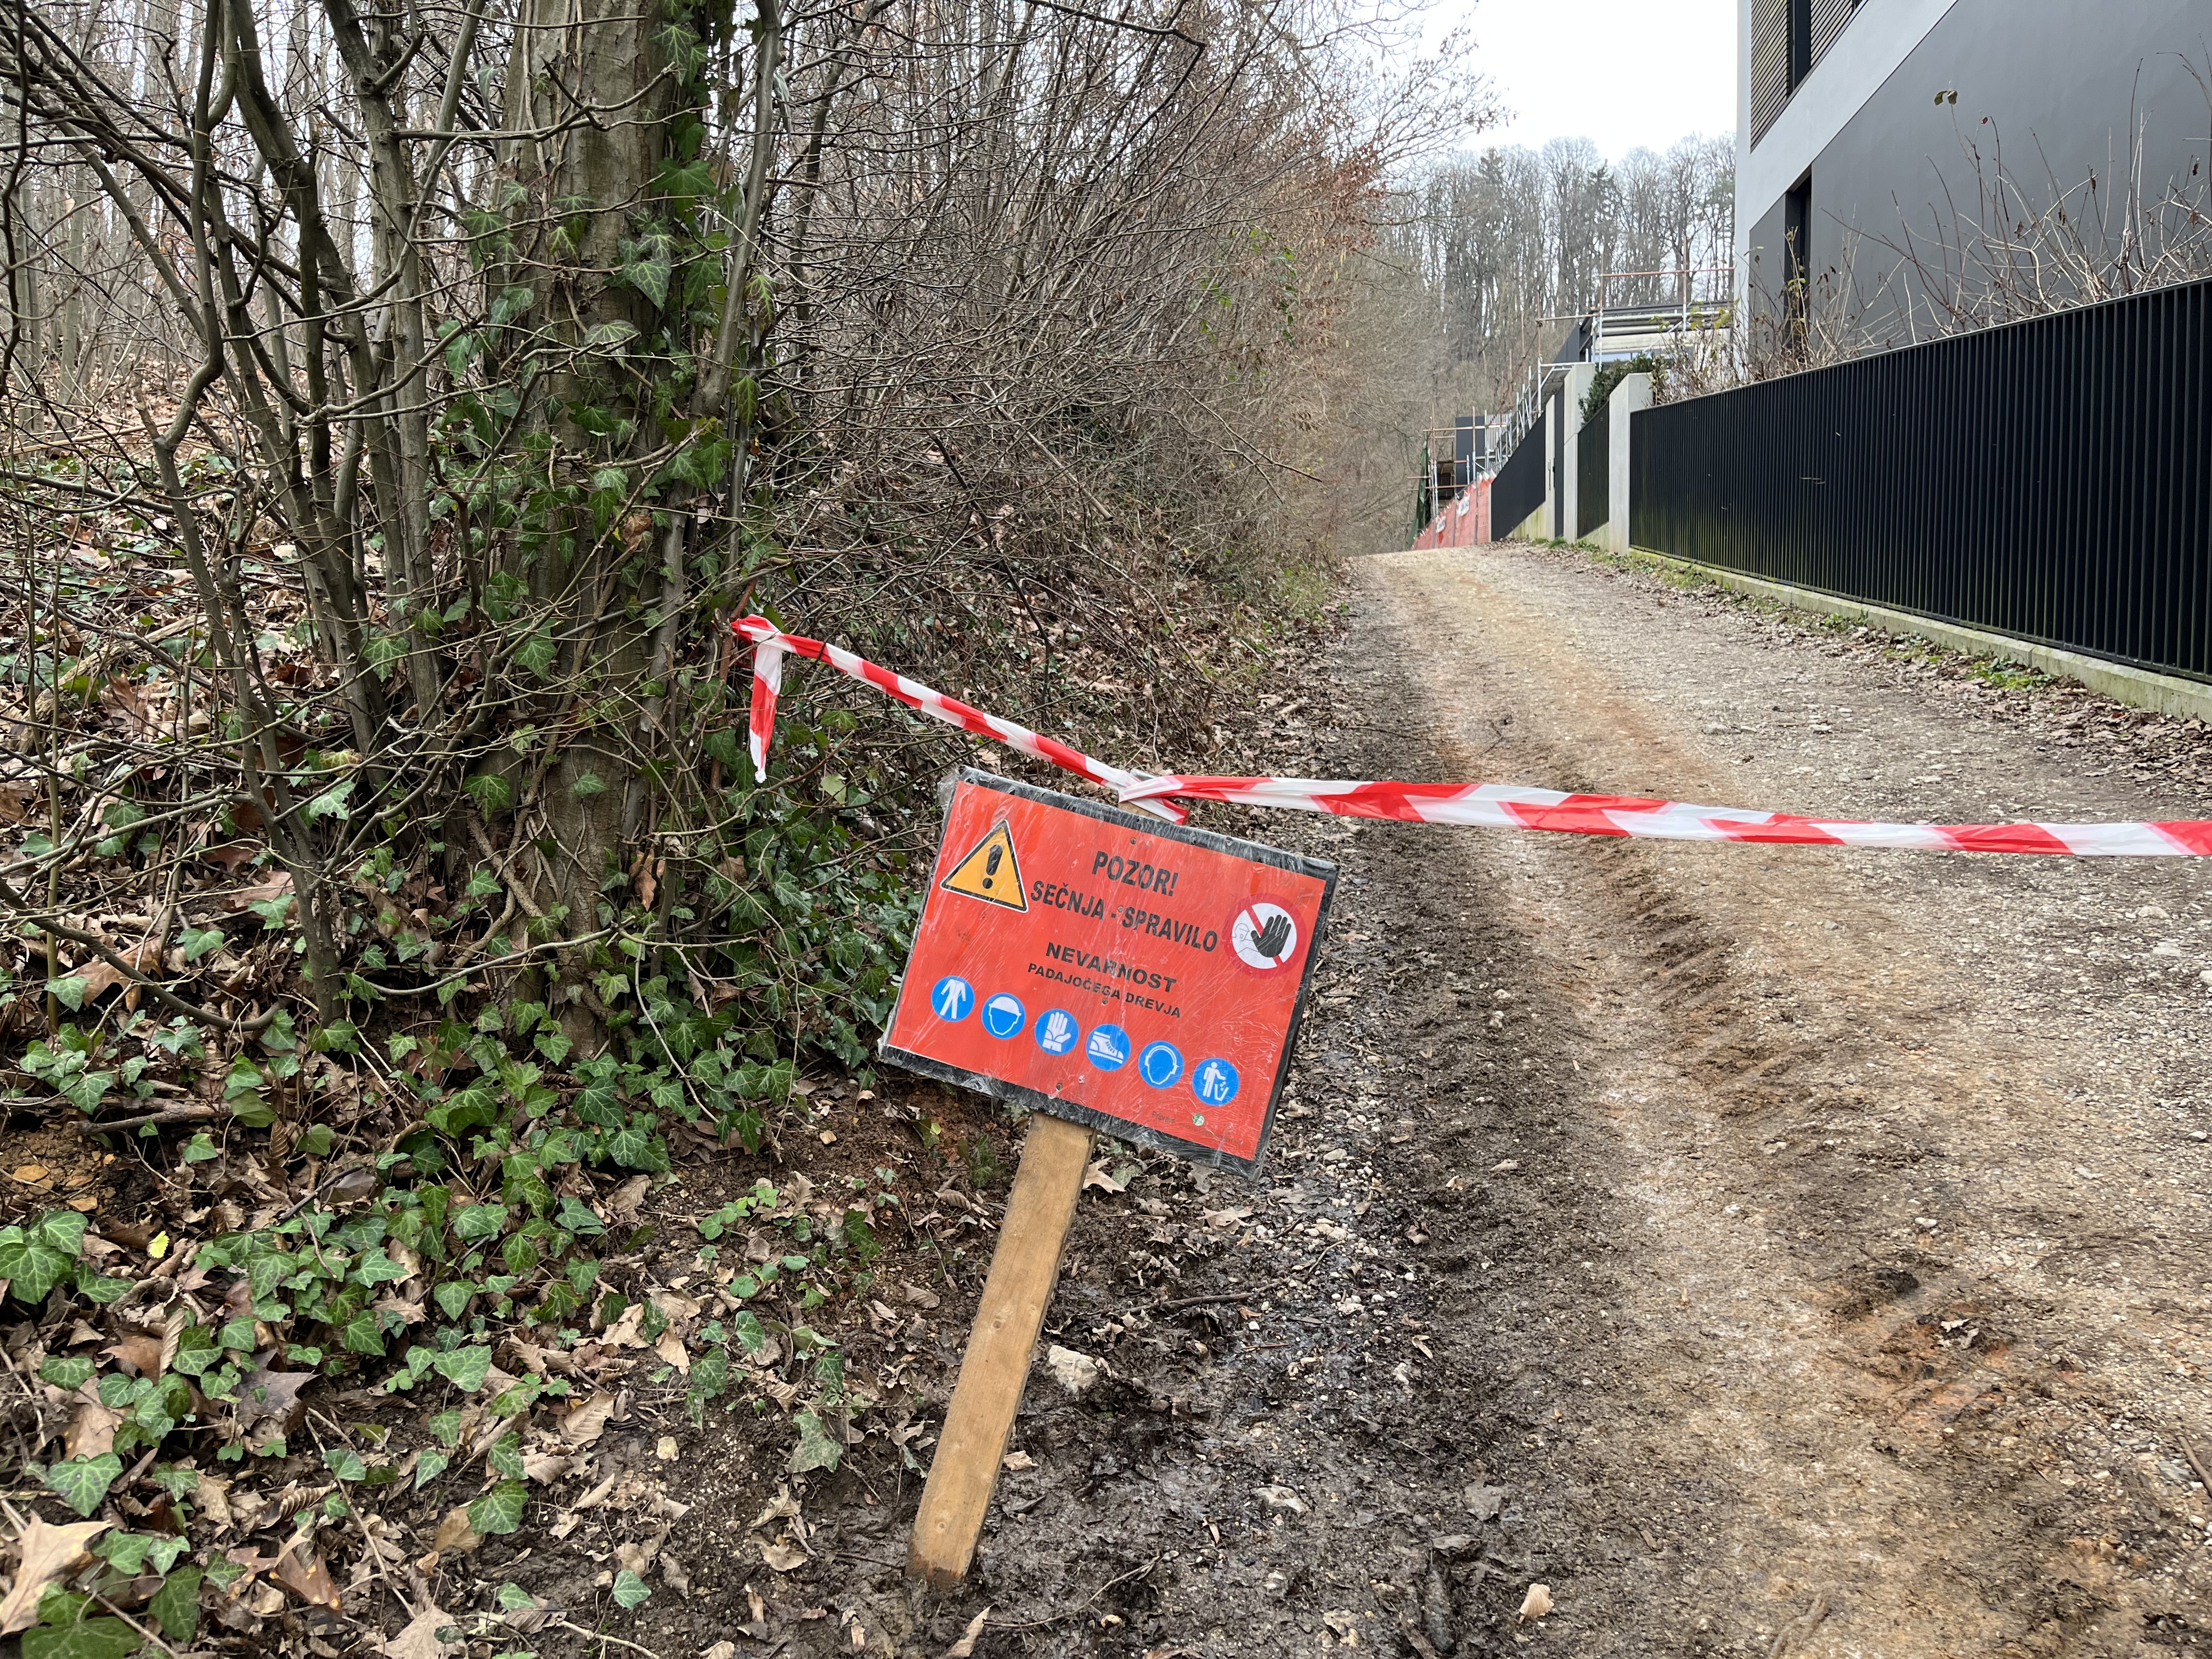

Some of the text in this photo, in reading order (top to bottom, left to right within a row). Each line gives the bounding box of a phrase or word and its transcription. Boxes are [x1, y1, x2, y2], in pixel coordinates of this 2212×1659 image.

[1091, 851, 1178, 896] POZOR!
[1031, 881, 1104, 920] SEČNJA
[1122, 906, 1218, 952] SPRAVILO
[1028, 963, 1181, 1018] PADAJOČEGA DREVJA
[1046, 942, 1177, 992] NEVARNOST
